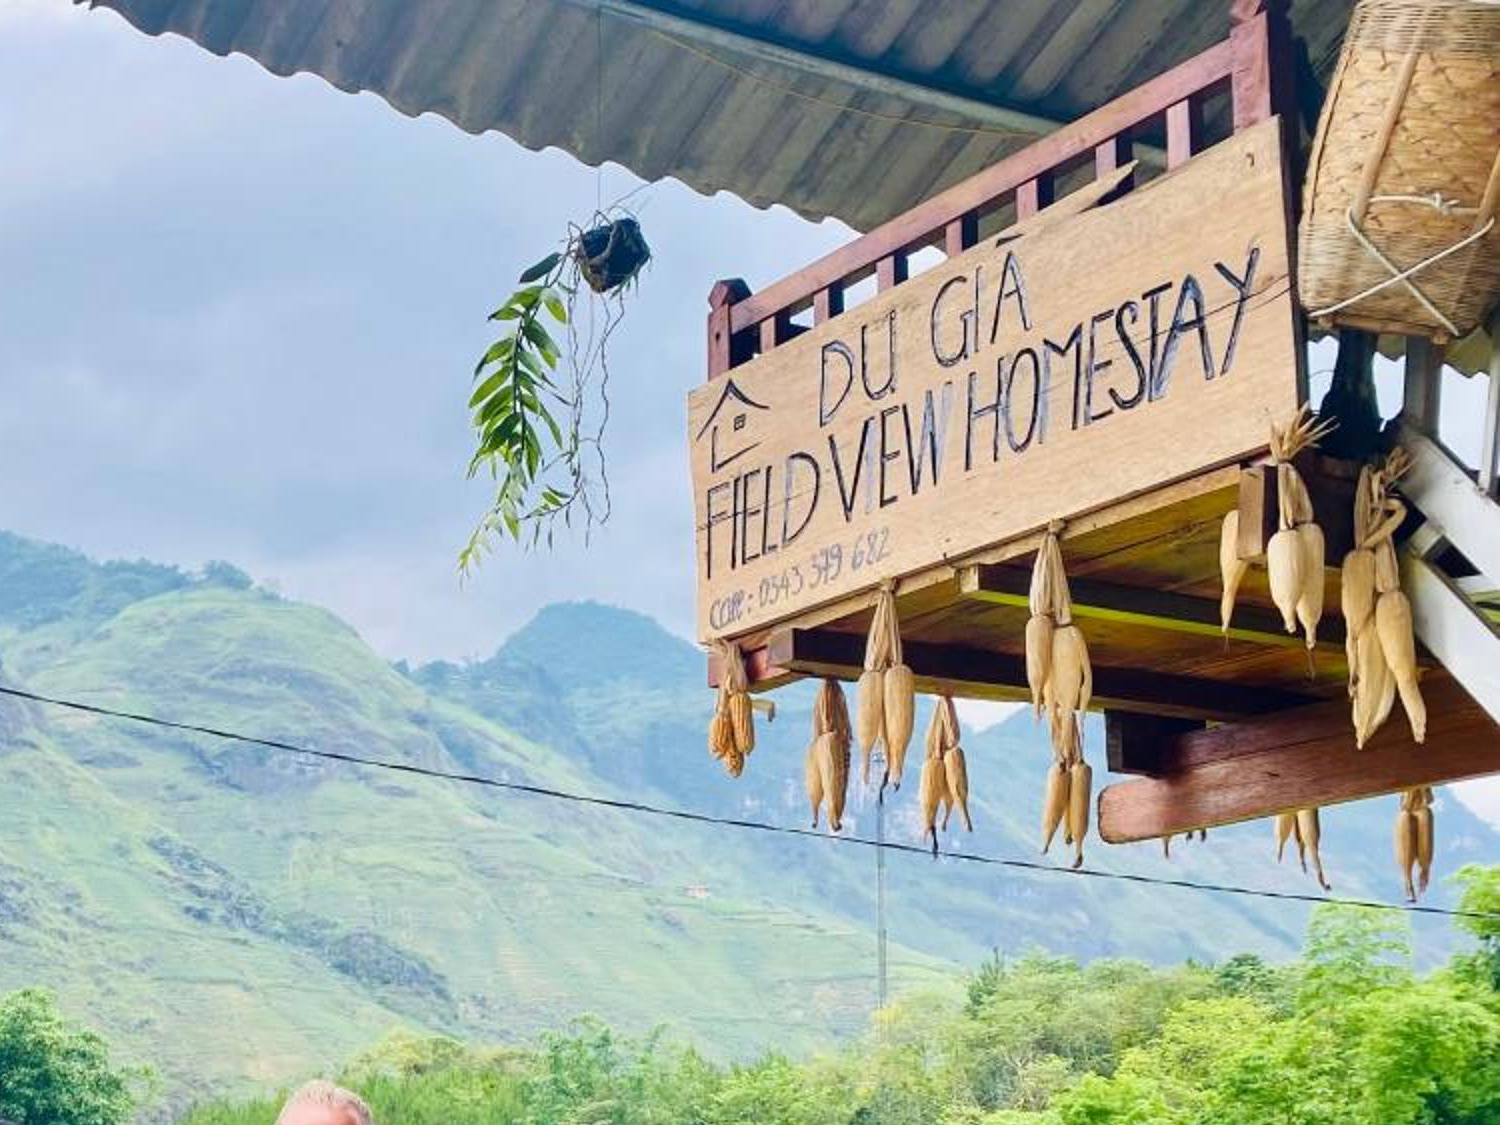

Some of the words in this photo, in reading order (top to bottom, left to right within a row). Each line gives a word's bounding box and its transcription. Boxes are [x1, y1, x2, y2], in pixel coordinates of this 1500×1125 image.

[706, 450, 822, 580] FIELD
[827, 380, 954, 523] VIEW
[964, 246, 1261, 473] HOMESTAY
